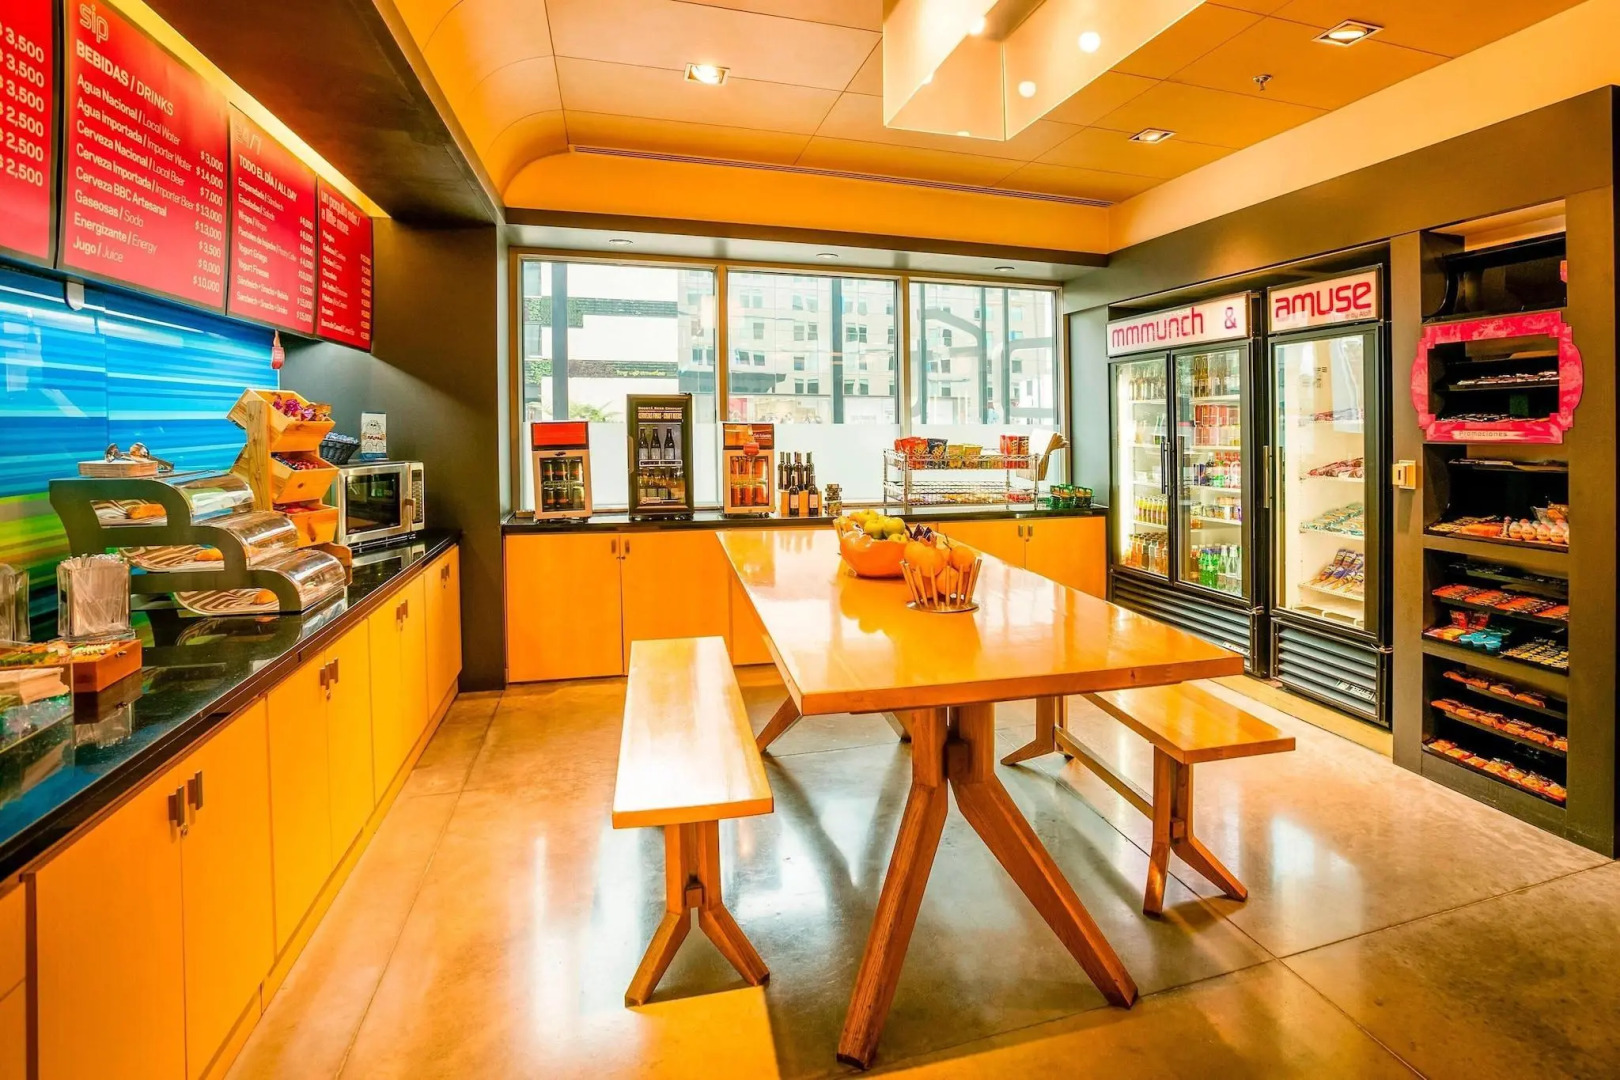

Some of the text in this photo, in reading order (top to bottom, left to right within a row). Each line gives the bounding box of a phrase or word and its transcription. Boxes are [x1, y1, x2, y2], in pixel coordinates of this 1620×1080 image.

[80, 4, 108, 43] sip
[76, 39, 128, 87] BEBIDAS
[137, 80, 173, 116] DRINKS
[78, 74, 101, 98] Agua
[102, 88, 137, 120] Nacional
[78, 97, 100, 120] Agua
[102, 110, 142, 144] importada
[76, 143, 112, 170] Cerveza
[113, 161, 151, 190] Importada
[77, 120, 113, 149] Cerveza
[114, 140, 148, 168] Nacional
[76, 167, 112, 194] Cerveza
[114, 183, 132, 201] BBC
[132, 193, 166, 216] Artesanal
[239, 154, 256, 174] TODO
[256, 166, 264, 181] EL
[278, 182, 286, 196] ALL
[287, 188, 297, 202] DAY
[75, 189, 118, 217] Gaseosas
[73, 236, 96, 254] Jugo
[102, 246, 123, 262] Juice
[74, 212, 126, 242] Energizante
[132, 234, 158, 254] Energy
[1276, 282, 1372, 318] amuse
[1112, 306, 1238, 348] mmmunch &
